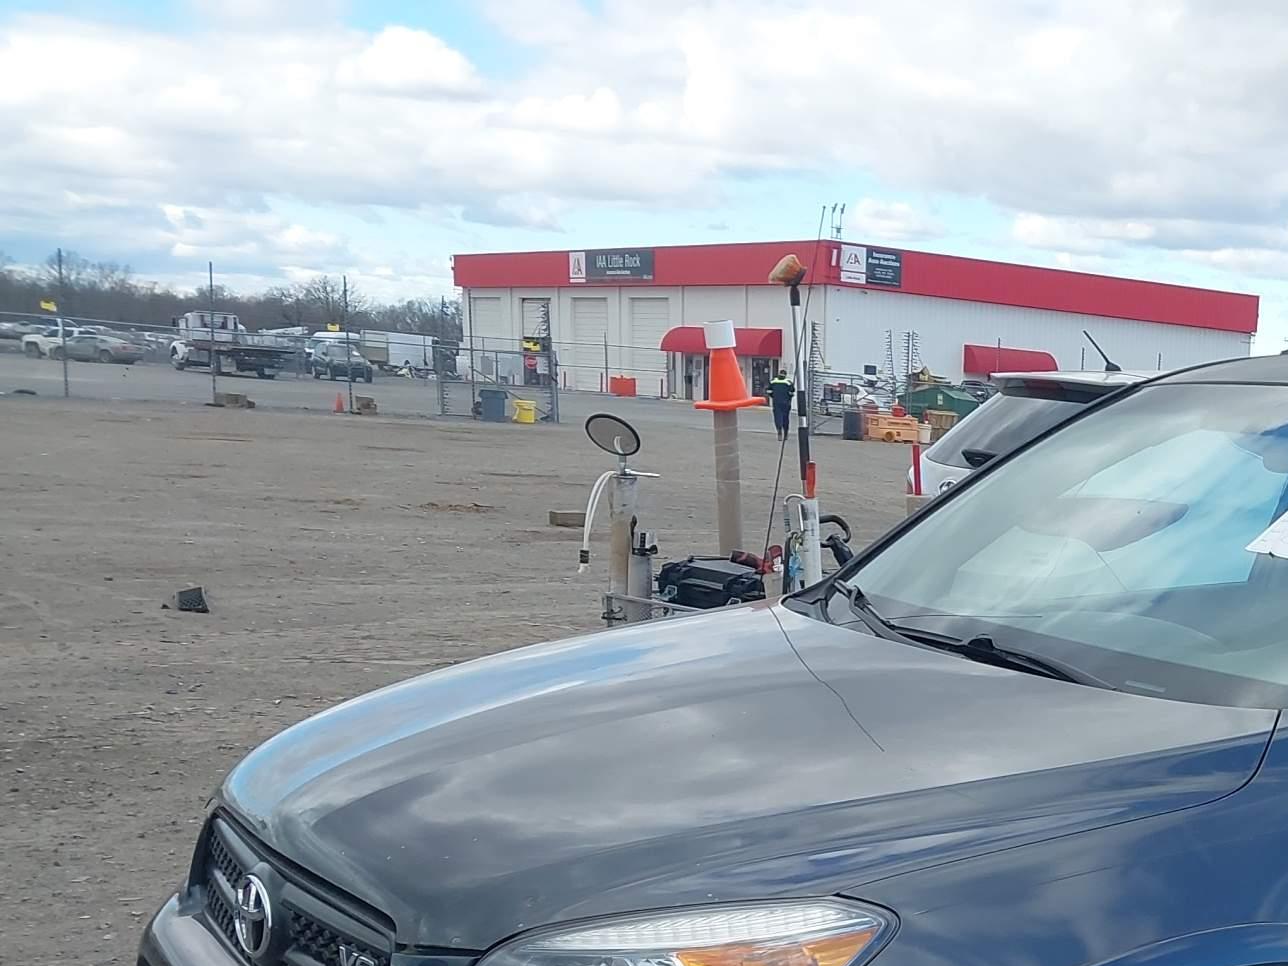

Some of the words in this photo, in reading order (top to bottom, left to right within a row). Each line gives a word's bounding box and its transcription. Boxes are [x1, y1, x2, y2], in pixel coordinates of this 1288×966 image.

[596, 255, 607, 268] IAA
[607, 254, 624, 268] Little
[624, 253, 641, 268] Rock
